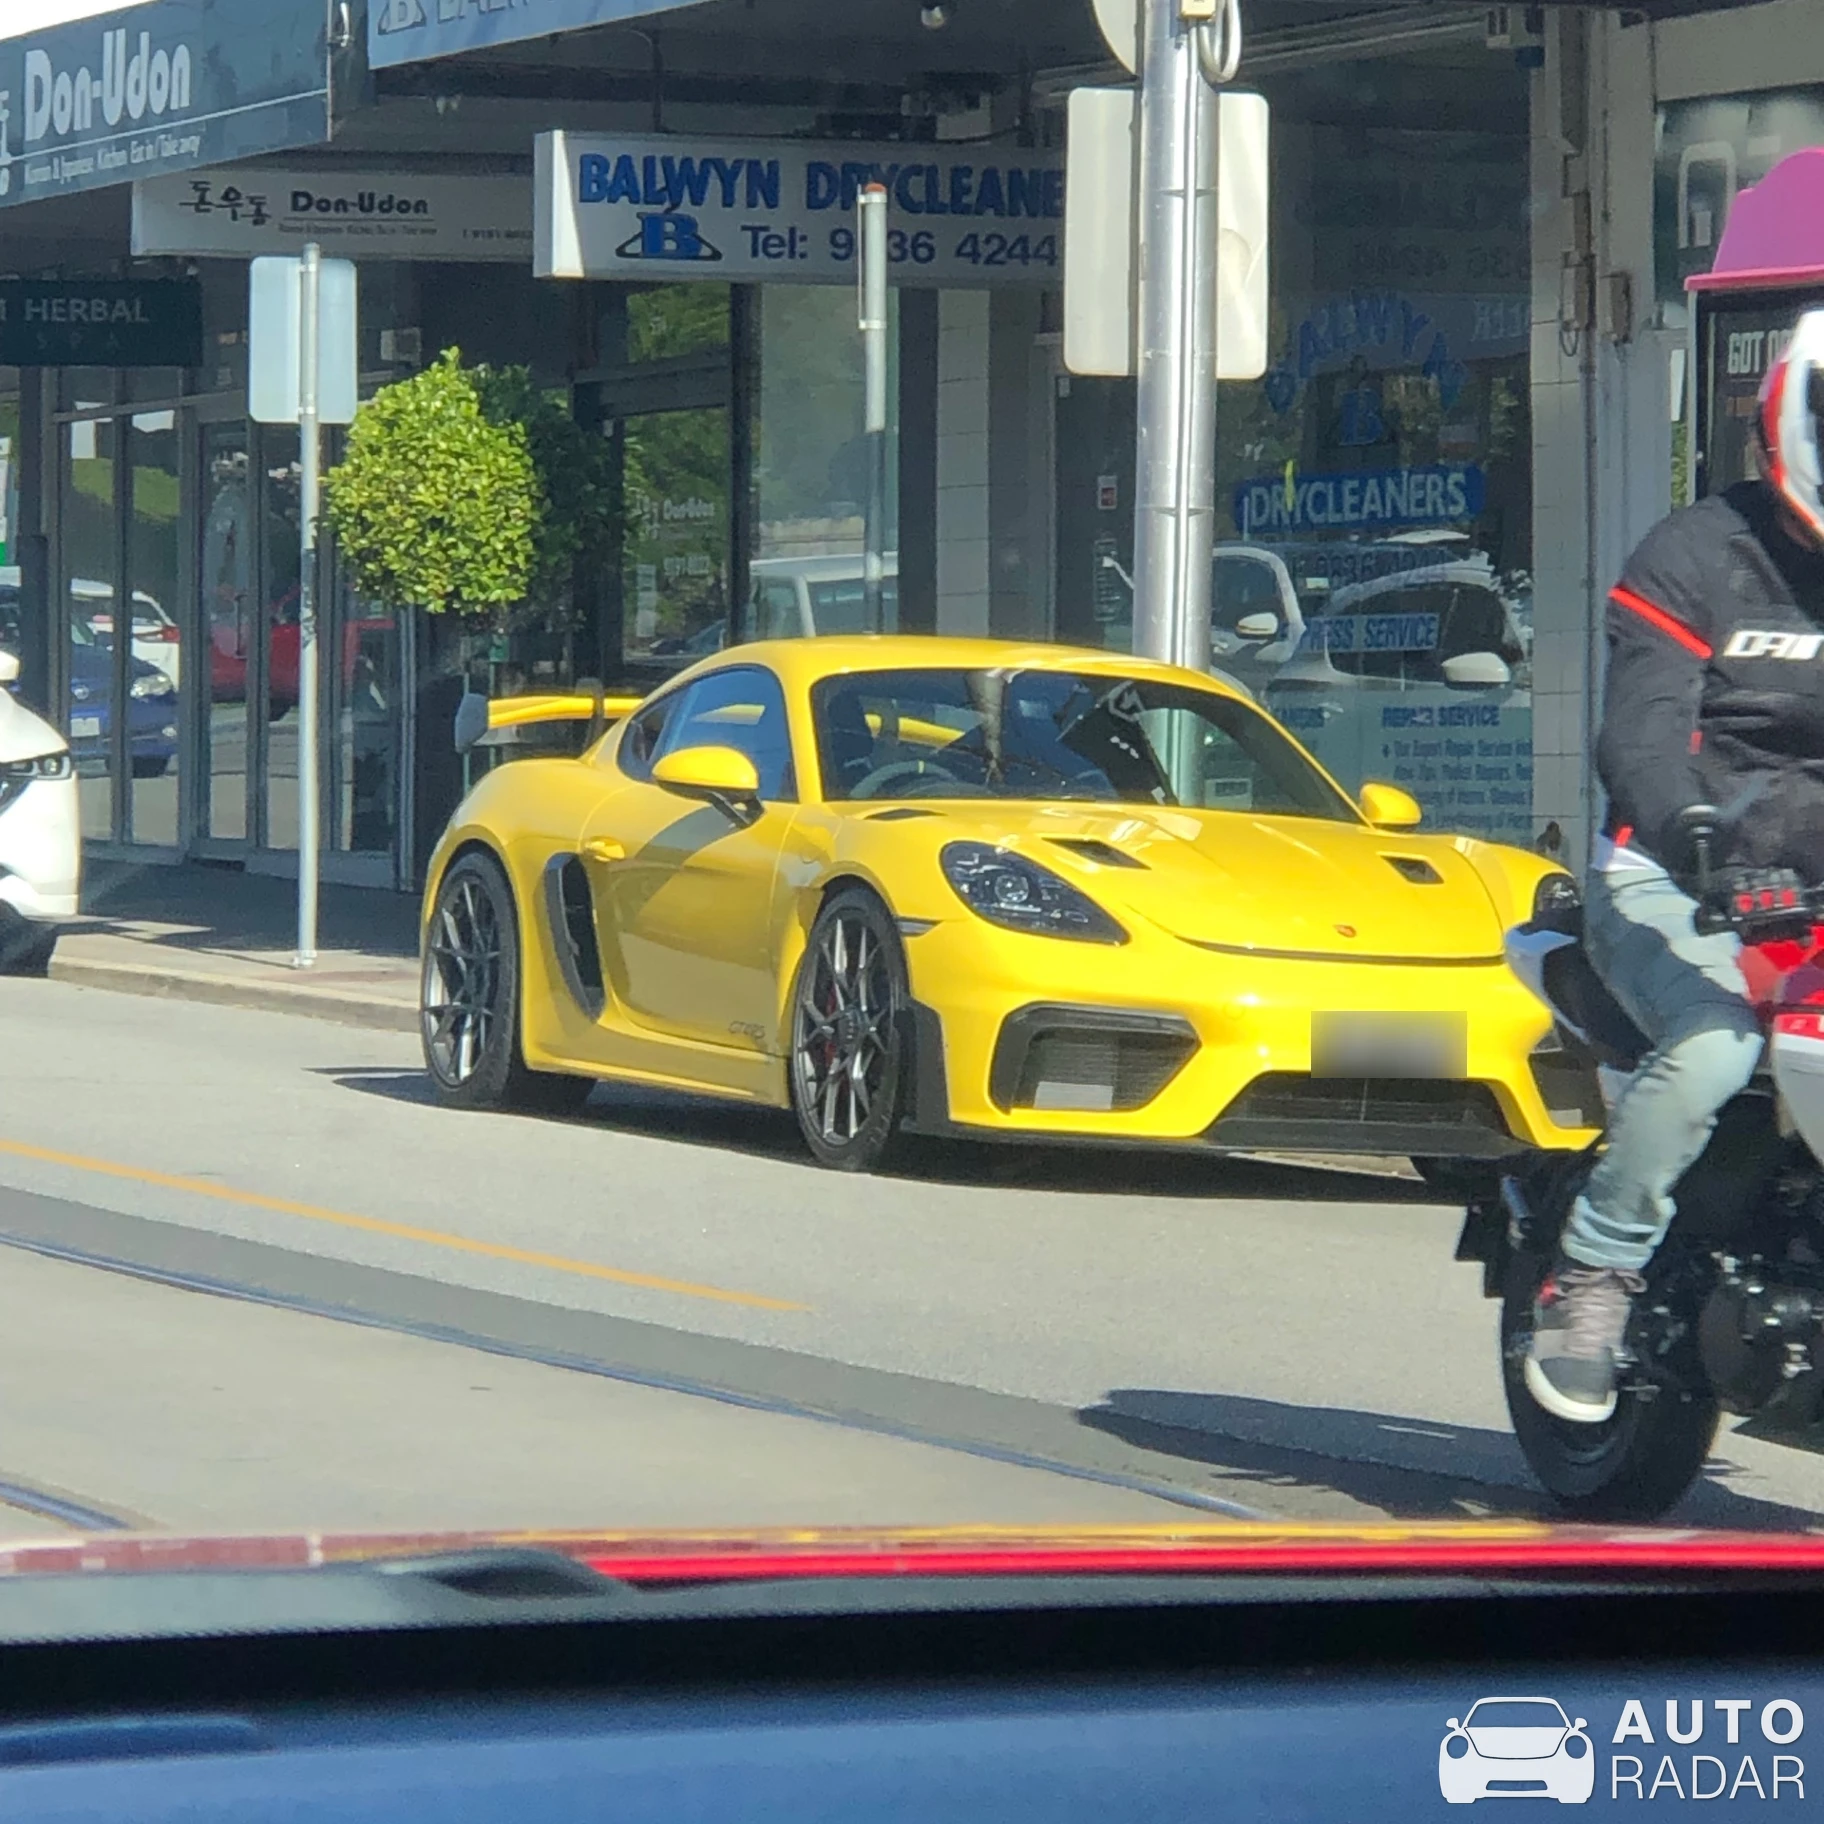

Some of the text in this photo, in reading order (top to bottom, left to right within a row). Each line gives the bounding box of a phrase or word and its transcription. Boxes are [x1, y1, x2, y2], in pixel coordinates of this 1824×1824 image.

[25, 28, 191, 142] Don-Udon
[180, 180, 272, 226] 돈우동
[290, 190, 428, 215] Don-Udon
[579, 153, 780, 210] BALWYN
[741, 224, 1059, 267] Tel: 936 4244
[25, 298, 150, 323] HERBAL
[1250, 471, 1467, 527] DRYCLEANERS
[1364, 616, 1437, 649] SERVICE
